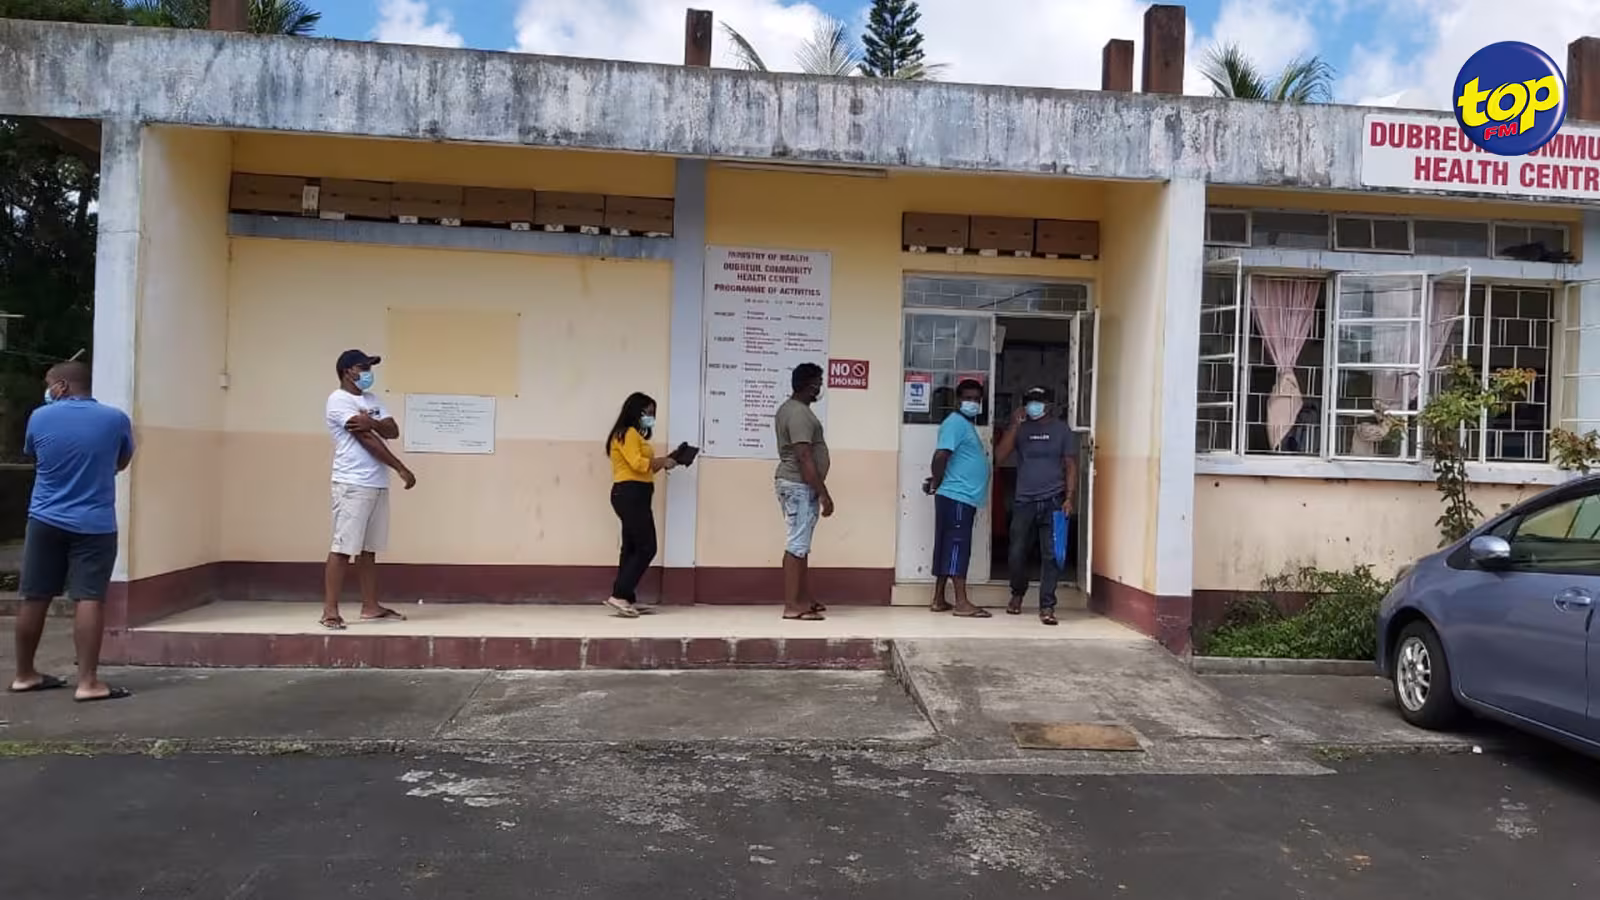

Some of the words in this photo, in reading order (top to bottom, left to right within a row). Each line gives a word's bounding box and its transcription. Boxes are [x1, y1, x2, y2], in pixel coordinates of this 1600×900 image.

[1370, 121, 1490, 154] DUBREU
[1414, 156, 1509, 187] HEALTH
[1519, 162, 1599, 192] CENTR
[728, 250, 765, 260] MINISTRY
[780, 254, 809, 262] HEALTH
[723, 262, 762, 273] DUBREUIL
[764, 264, 813, 275] COMMUNITY
[737, 273, 767, 282] HEALTH
[768, 274, 799, 284] CENTRE
[714, 283, 766, 294] PROGRAMME
[768, 286, 777, 295] OF
[780, 287, 821, 296] ACTIVITIES
[831, 363, 850, 376] NO
[830, 377, 866, 387] SMOKING
